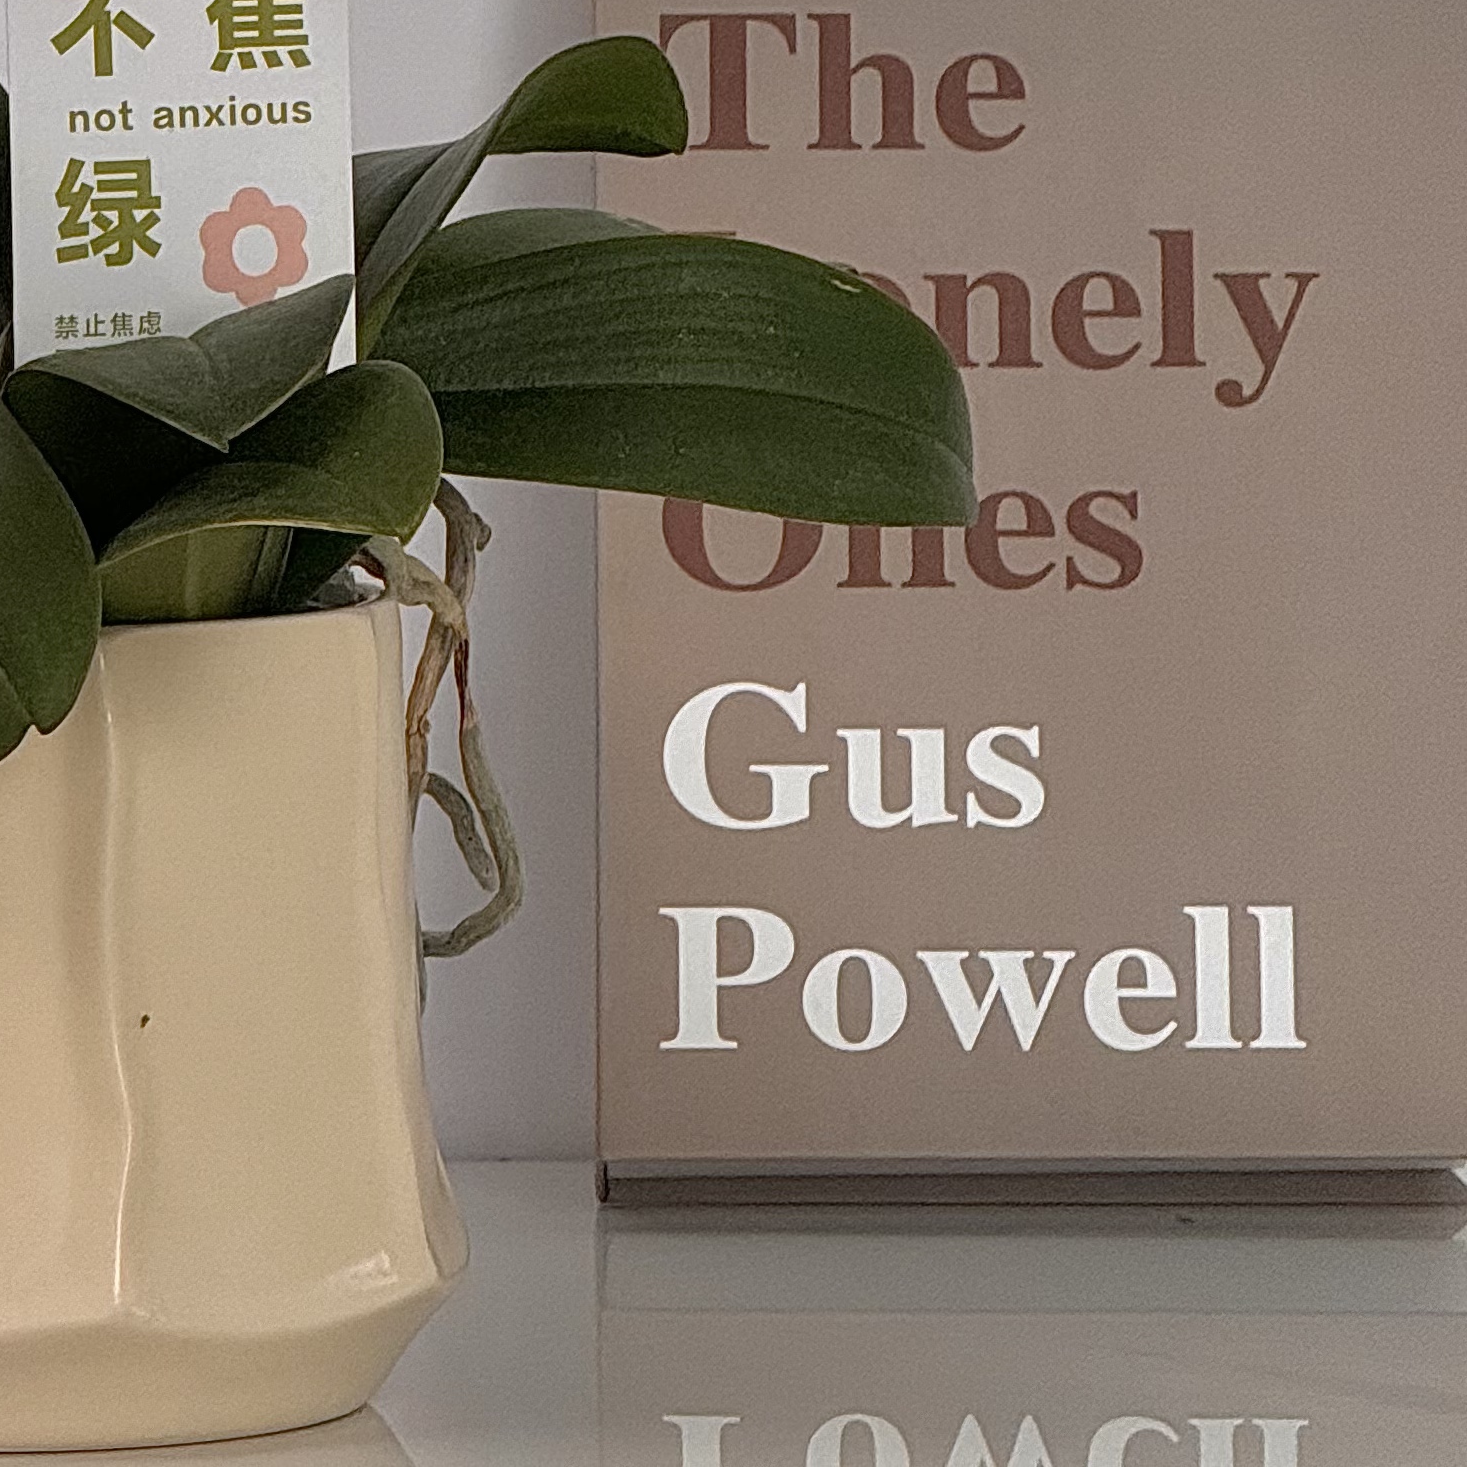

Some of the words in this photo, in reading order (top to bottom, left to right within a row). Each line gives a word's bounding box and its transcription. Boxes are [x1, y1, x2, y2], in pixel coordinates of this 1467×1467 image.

[69, 101, 133, 132] not
[153, 95, 312, 130] anxious
[658, 13, 1026, 153] The
[55, 158, 162, 267] 绿
[54, 310, 162, 340] 禁止焦虑
[857, 229, 1321, 409] nely
[663, 681, 1045, 830] Gus
[659, 905, 1308, 1051] Powell
